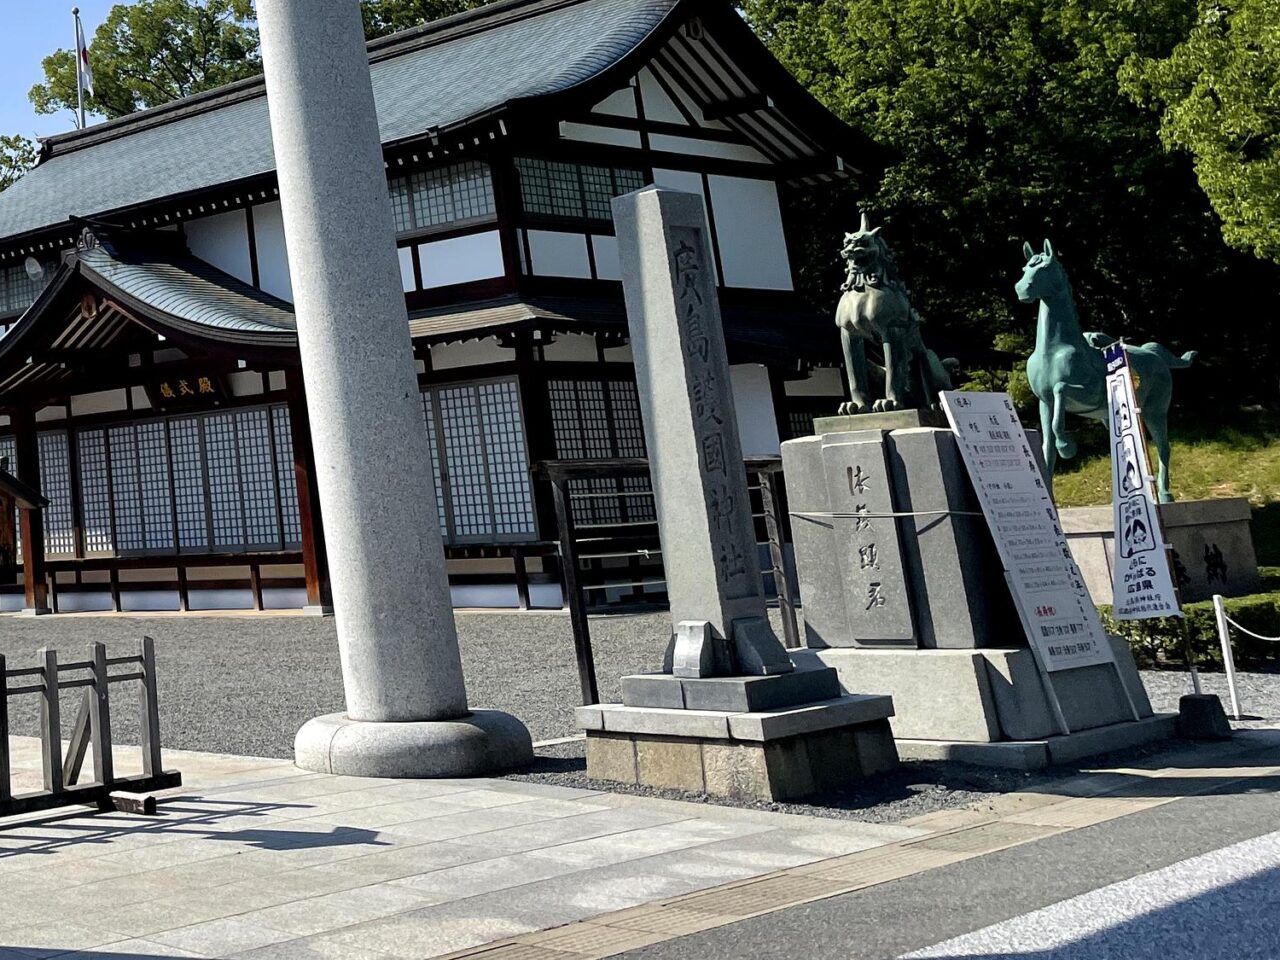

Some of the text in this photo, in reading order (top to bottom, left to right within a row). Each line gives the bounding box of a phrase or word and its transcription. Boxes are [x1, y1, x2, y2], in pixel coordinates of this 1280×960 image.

[160, 376, 216, 398] 儀式殿
[672, 240, 746, 582] 廣島護國神社
